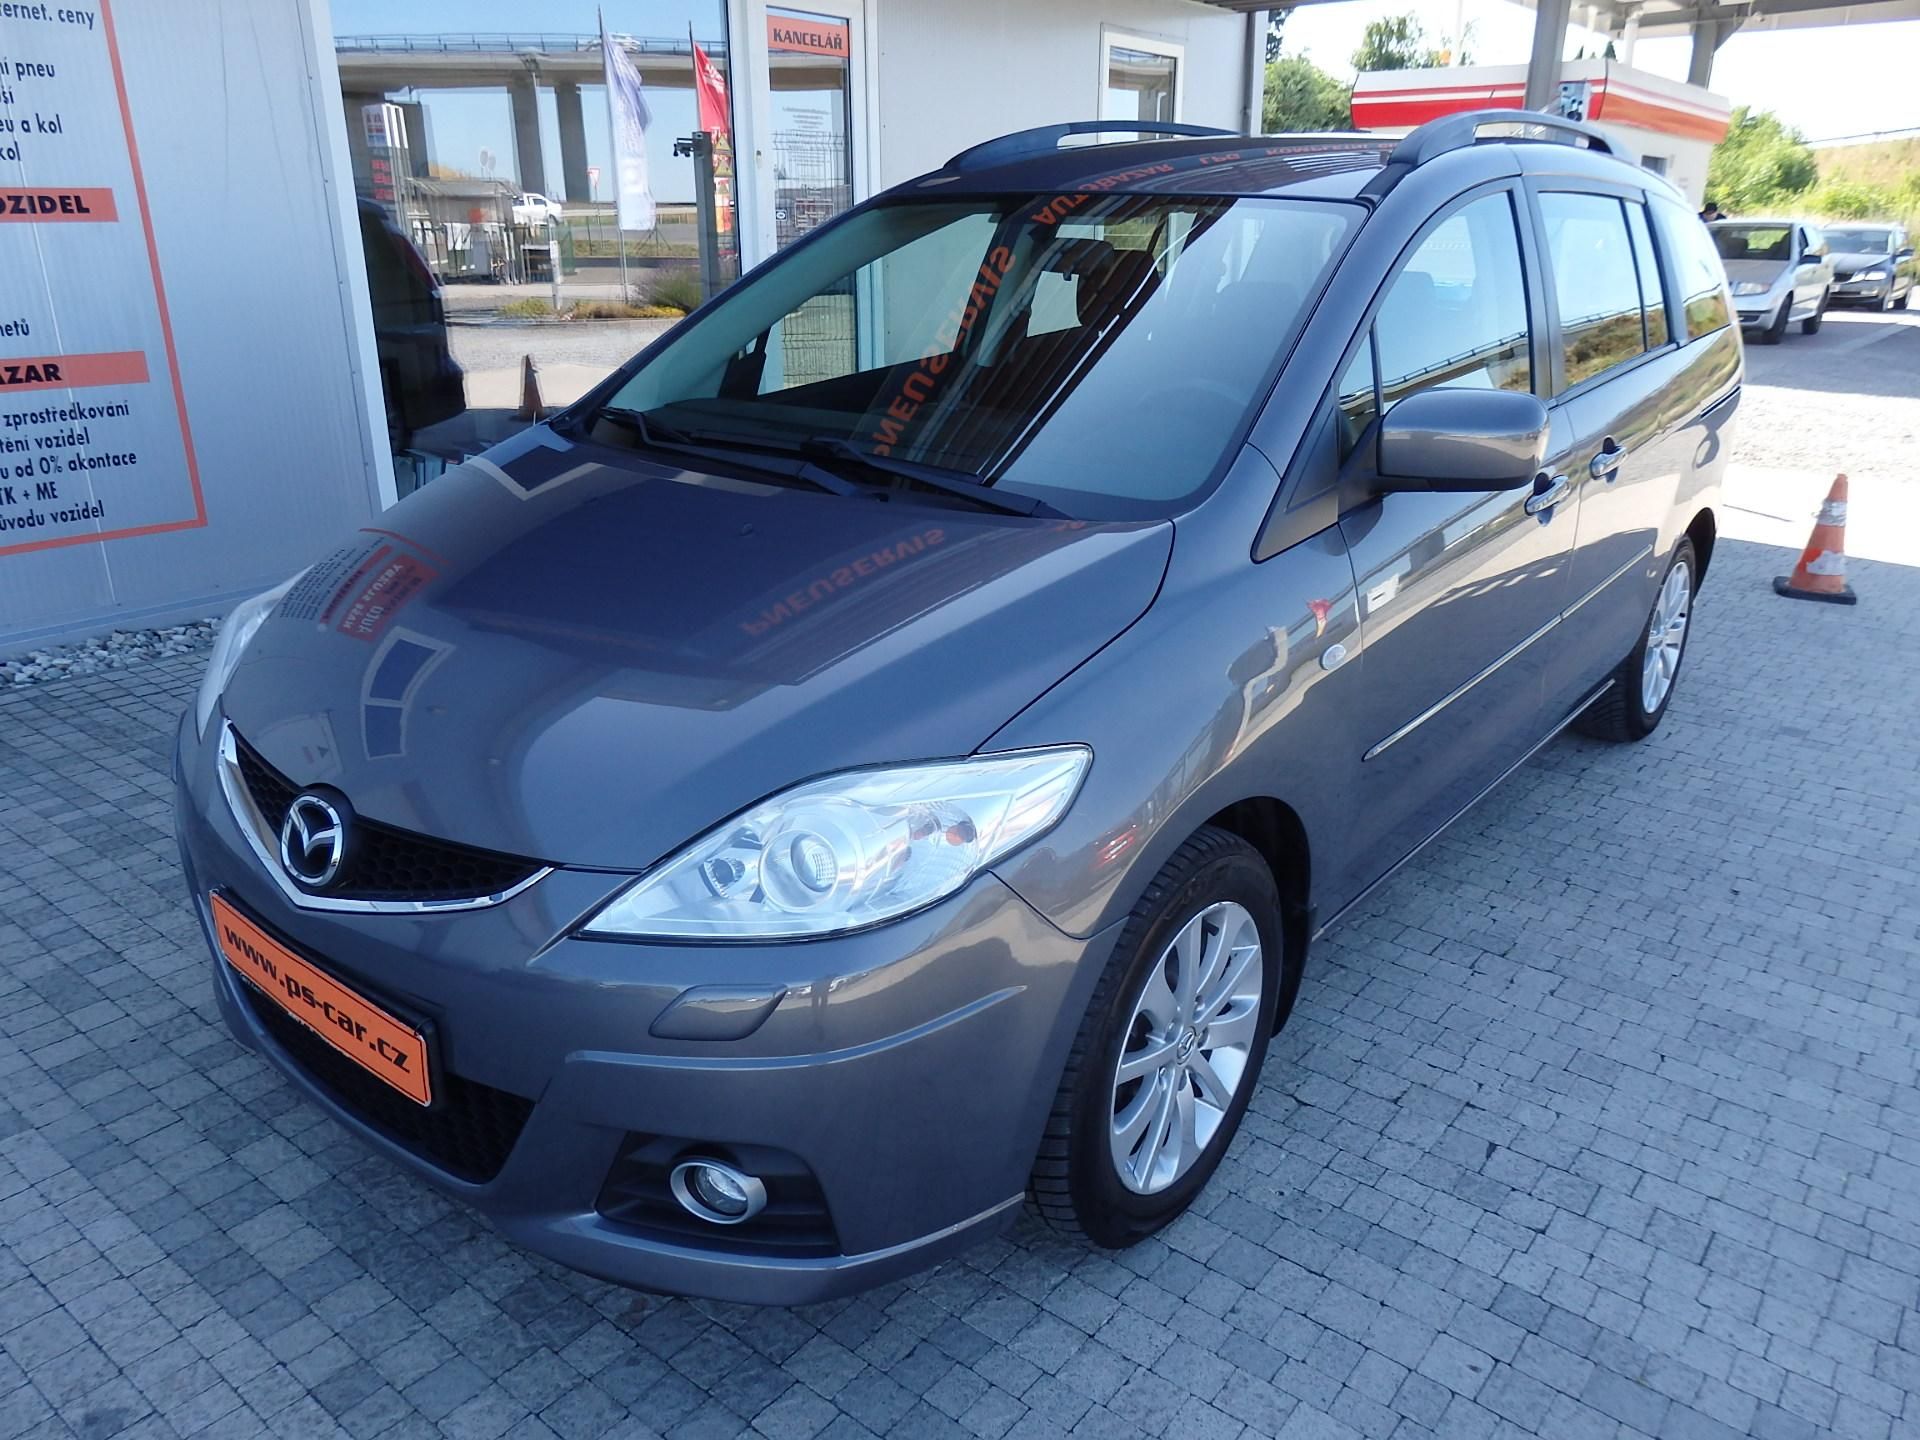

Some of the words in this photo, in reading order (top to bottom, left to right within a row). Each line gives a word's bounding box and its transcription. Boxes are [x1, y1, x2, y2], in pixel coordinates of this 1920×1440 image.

[58, 9, 95, 31] ceny
[773, 28, 843, 50] KANCELÁŘ
[16, 61, 56, 82] pneu
[21, 119, 32, 133] a
[36, 113, 63, 134] kol
[3, 399, 130, 431] zprostředkování
[34, 426, 91, 450] vozidel
[15, 458, 35, 478] od
[39, 455, 64, 474] 0%
[68, 451, 138, 472] akontace
[36, 481, 59, 501] ME
[51, 499, 105, 524] vozidel
[224, 924, 411, 1074] www.ps-car.cz
